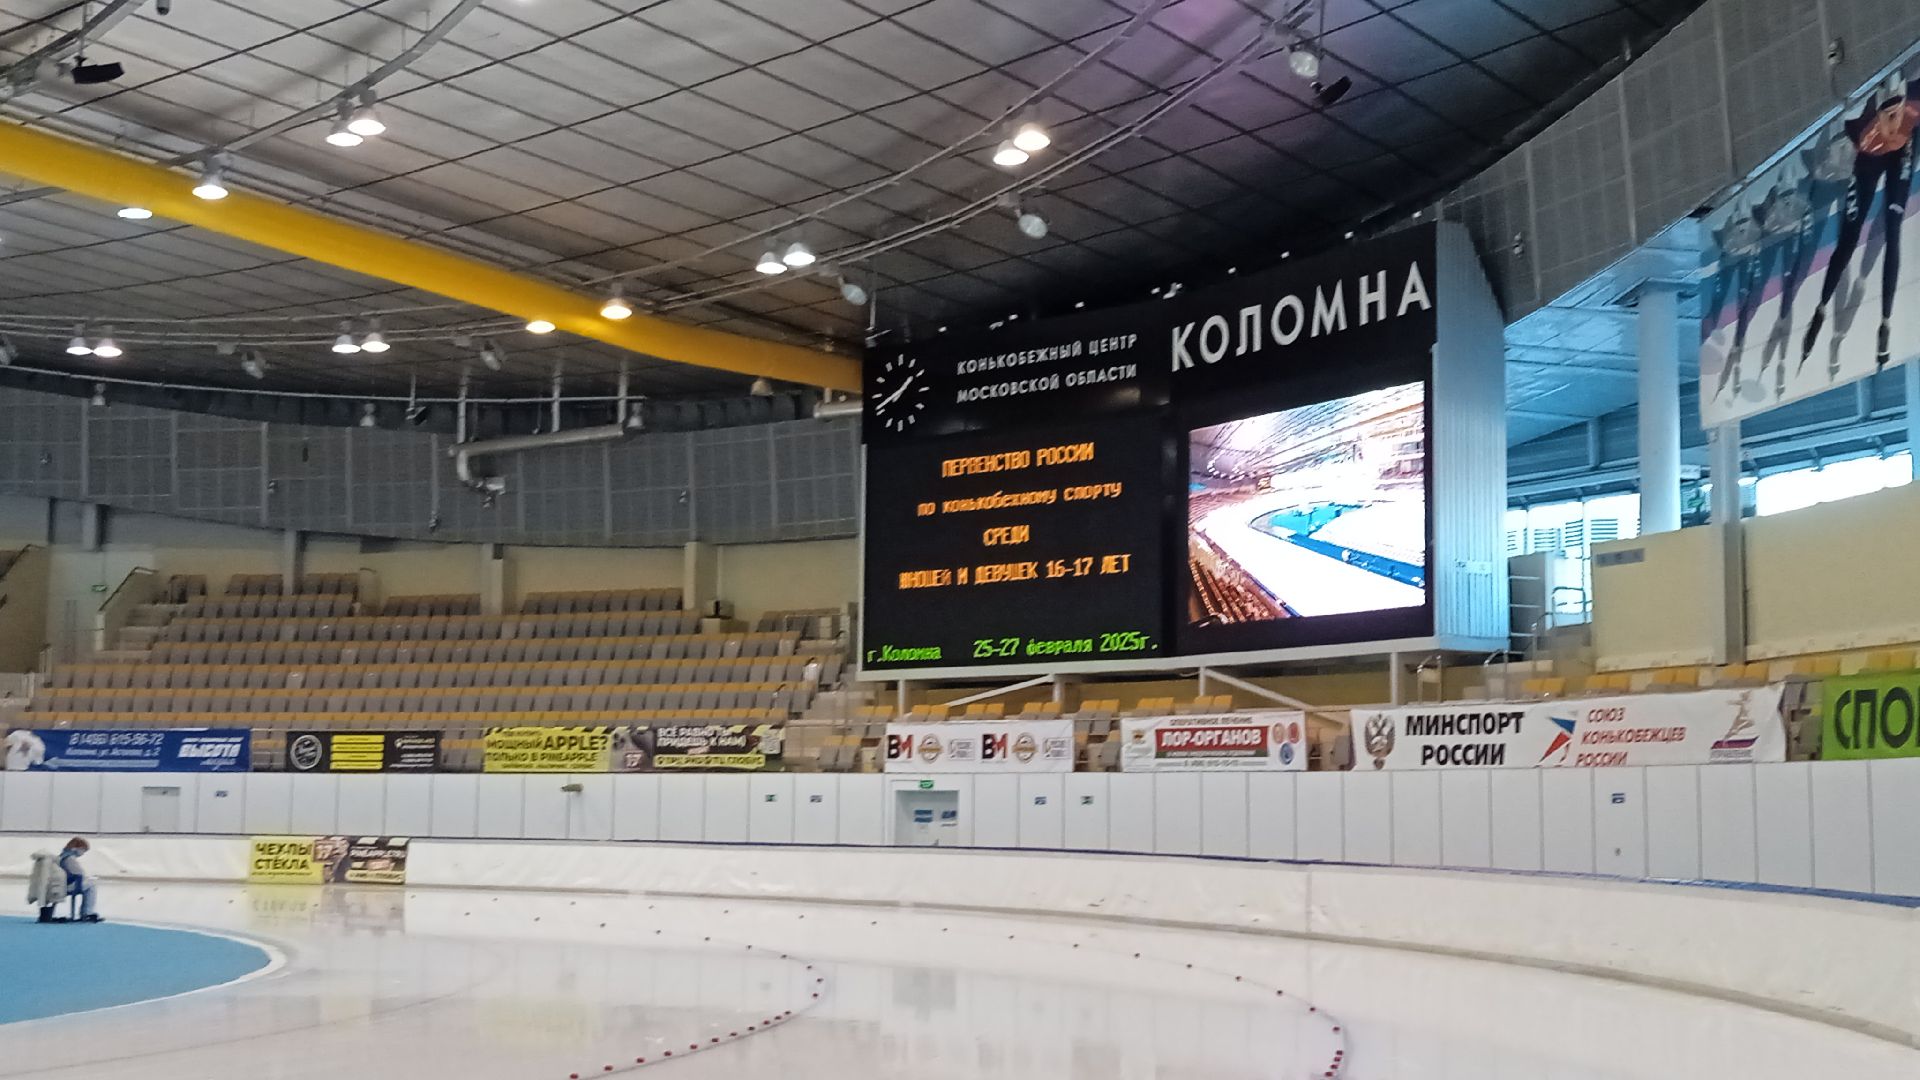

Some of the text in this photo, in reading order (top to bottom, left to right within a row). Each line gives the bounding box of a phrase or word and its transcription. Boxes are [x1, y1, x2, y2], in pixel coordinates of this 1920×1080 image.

[1171, 261, 1432, 372] КОЛОМНА
[956, 333, 1138, 375] КОНЬКОБЕЖНЫЙ ЦЕНТР
[956, 363, 1137, 404] МОСКОВСКОЙ ОБЛАСТИ
[942, 442, 1095, 478] ПЕРВЕНСТВО РОССИИ
[917, 482, 1122, 517] по конькобежному спорту
[982, 524, 1030, 546] СРЕДИ
[898, 553, 1132, 590] ЮНОШЕЙ И ДЕВУШЕК 16-17 ЛЕТ
[973, 637, 1021, 658] 25-27
[1026, 638, 1093, 657] февраля
[1405, 711, 1525, 736] МИНСПОРТ
[1587, 707, 1626, 723] СОЮЗ
[1834, 686, 1920, 750] СПО
[542, 735, 608, 750] APPLE?
[1161, 729, 1262, 747] ЛОР-ОРГАНОВ
[1581, 726, 1687, 745] КОНЬКОБЕЖЦЕВ
[1421, 743, 1506, 766] РОССИИ
[1574, 751, 1629, 767] РОССИИ
[255, 842, 312, 856] ЧЕХЛЫ
